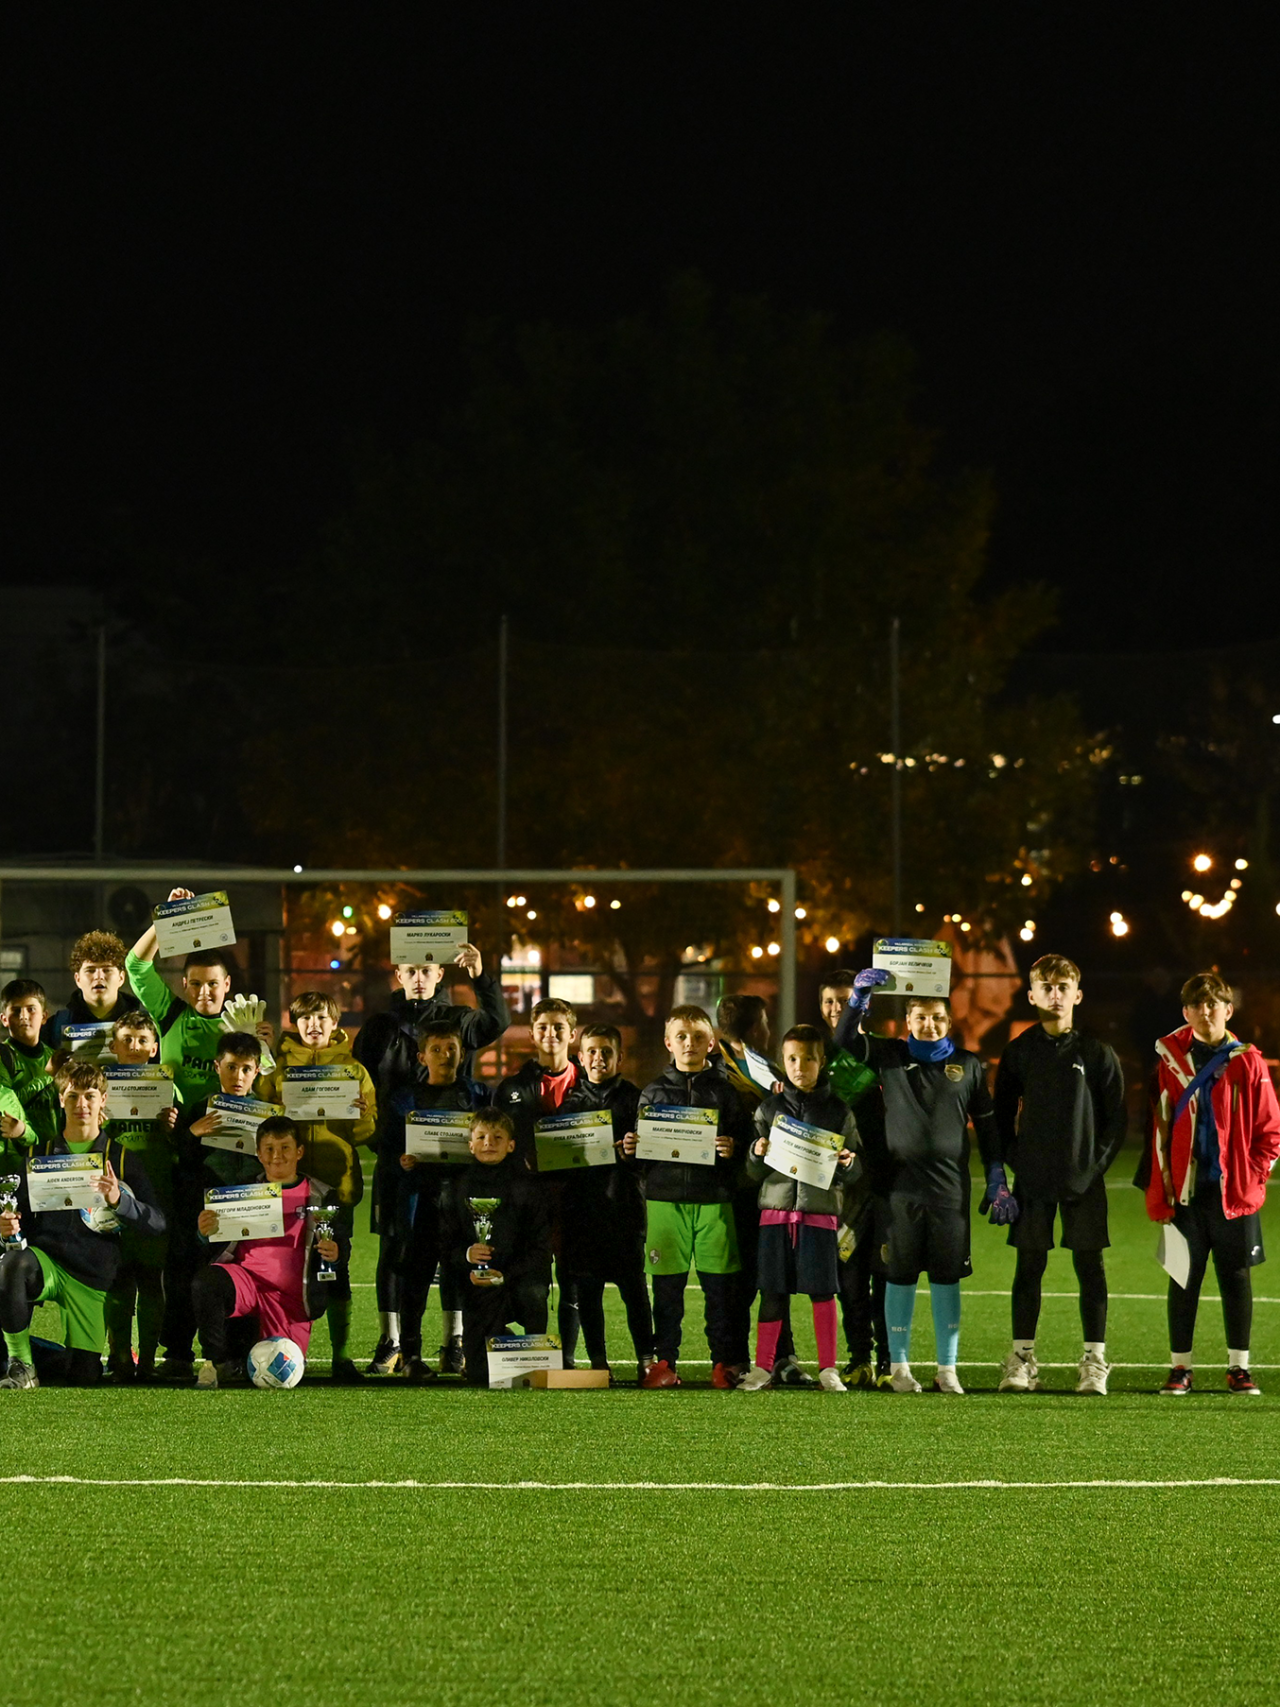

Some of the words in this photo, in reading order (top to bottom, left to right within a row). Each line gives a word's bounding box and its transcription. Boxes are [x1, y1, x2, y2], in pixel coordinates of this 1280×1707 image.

[156, 905, 186, 916] KEEPERS
[186, 900, 210, 910] CLASH
[172, 919, 190, 927] АНДРЕЈ
[190, 915, 213, 924] ПЕТРЕСКИ
[212, 1100, 242, 1110] KEEPERS
[243, 1105, 266, 1114] CLASH
[226, 1116, 245, 1125] СТЕФАН
[539, 1121, 569, 1129] KEEPERS
[777, 1121, 803, 1136] KEEPERS
[803, 1131, 826, 1143] CLASH
[794, 1143, 821, 1157] МИТРОВСКИ
[209, 1192, 239, 1200] KEEPERS
